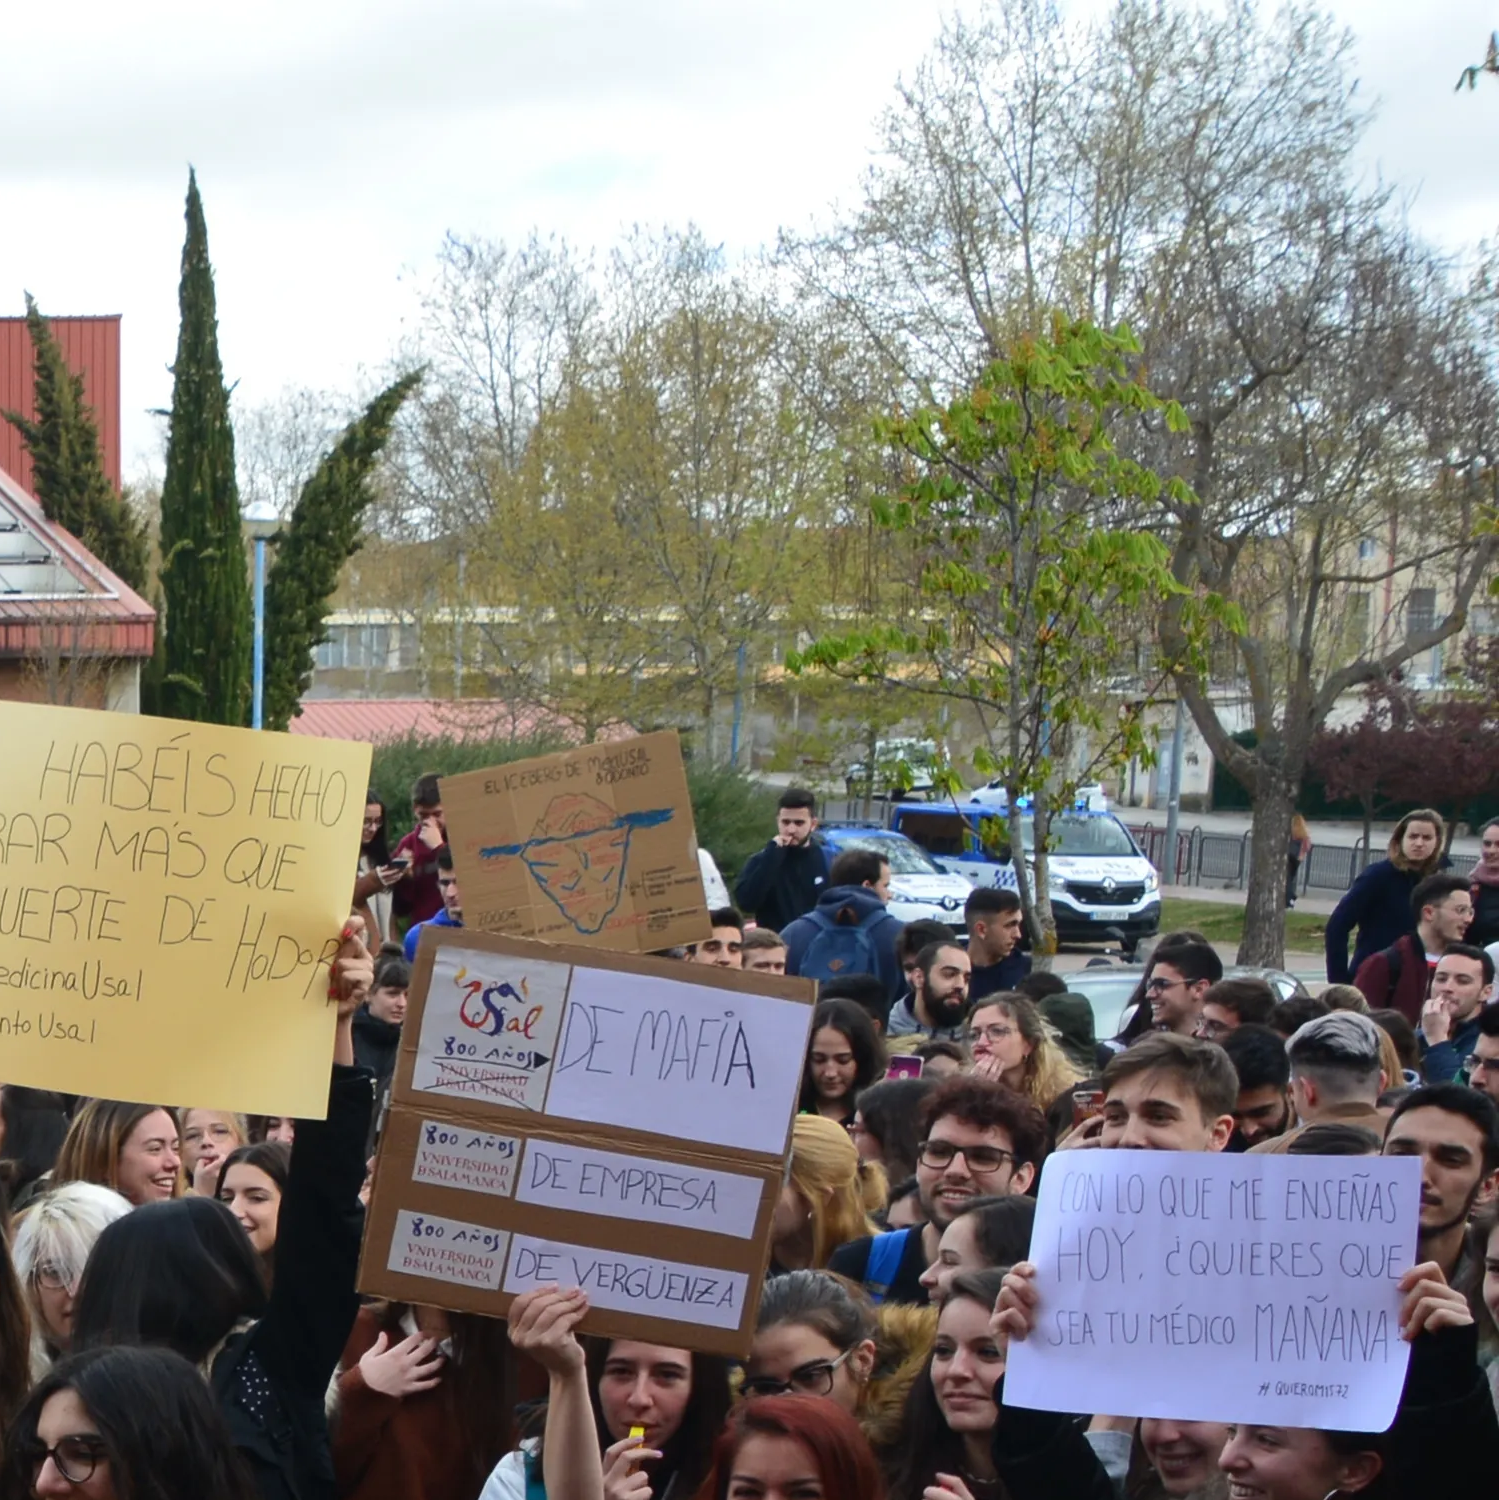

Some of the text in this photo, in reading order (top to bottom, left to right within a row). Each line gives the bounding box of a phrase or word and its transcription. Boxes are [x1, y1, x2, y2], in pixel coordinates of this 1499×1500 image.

[39, 732, 236, 819] HABÉIS
[249, 760, 348, 828] HECHO
[94, 820, 206, 879] MÁS
[224, 837, 306, 894] QUE
[159, 895, 216, 944] DE
[443, 1036, 478, 1057] 800
[556, 1001, 625, 1075] DE
[425, 1125, 459, 1145] 800
[530, 1152, 718, 1214] DE EMPRESA
[1058, 1171, 1399, 1223] CON LO QUE ME ENSEÑAS
[411, 1217, 445, 1237] 800
[514, 1248, 734, 1309] DE VERGÜENZA
[1339, 1243, 1402, 1280] QUE
[1048, 1310, 1095, 1346] SEA
[1104, 1311, 1139, 1345] TU
[1149, 1306, 1236, 1346] MÉDICO
